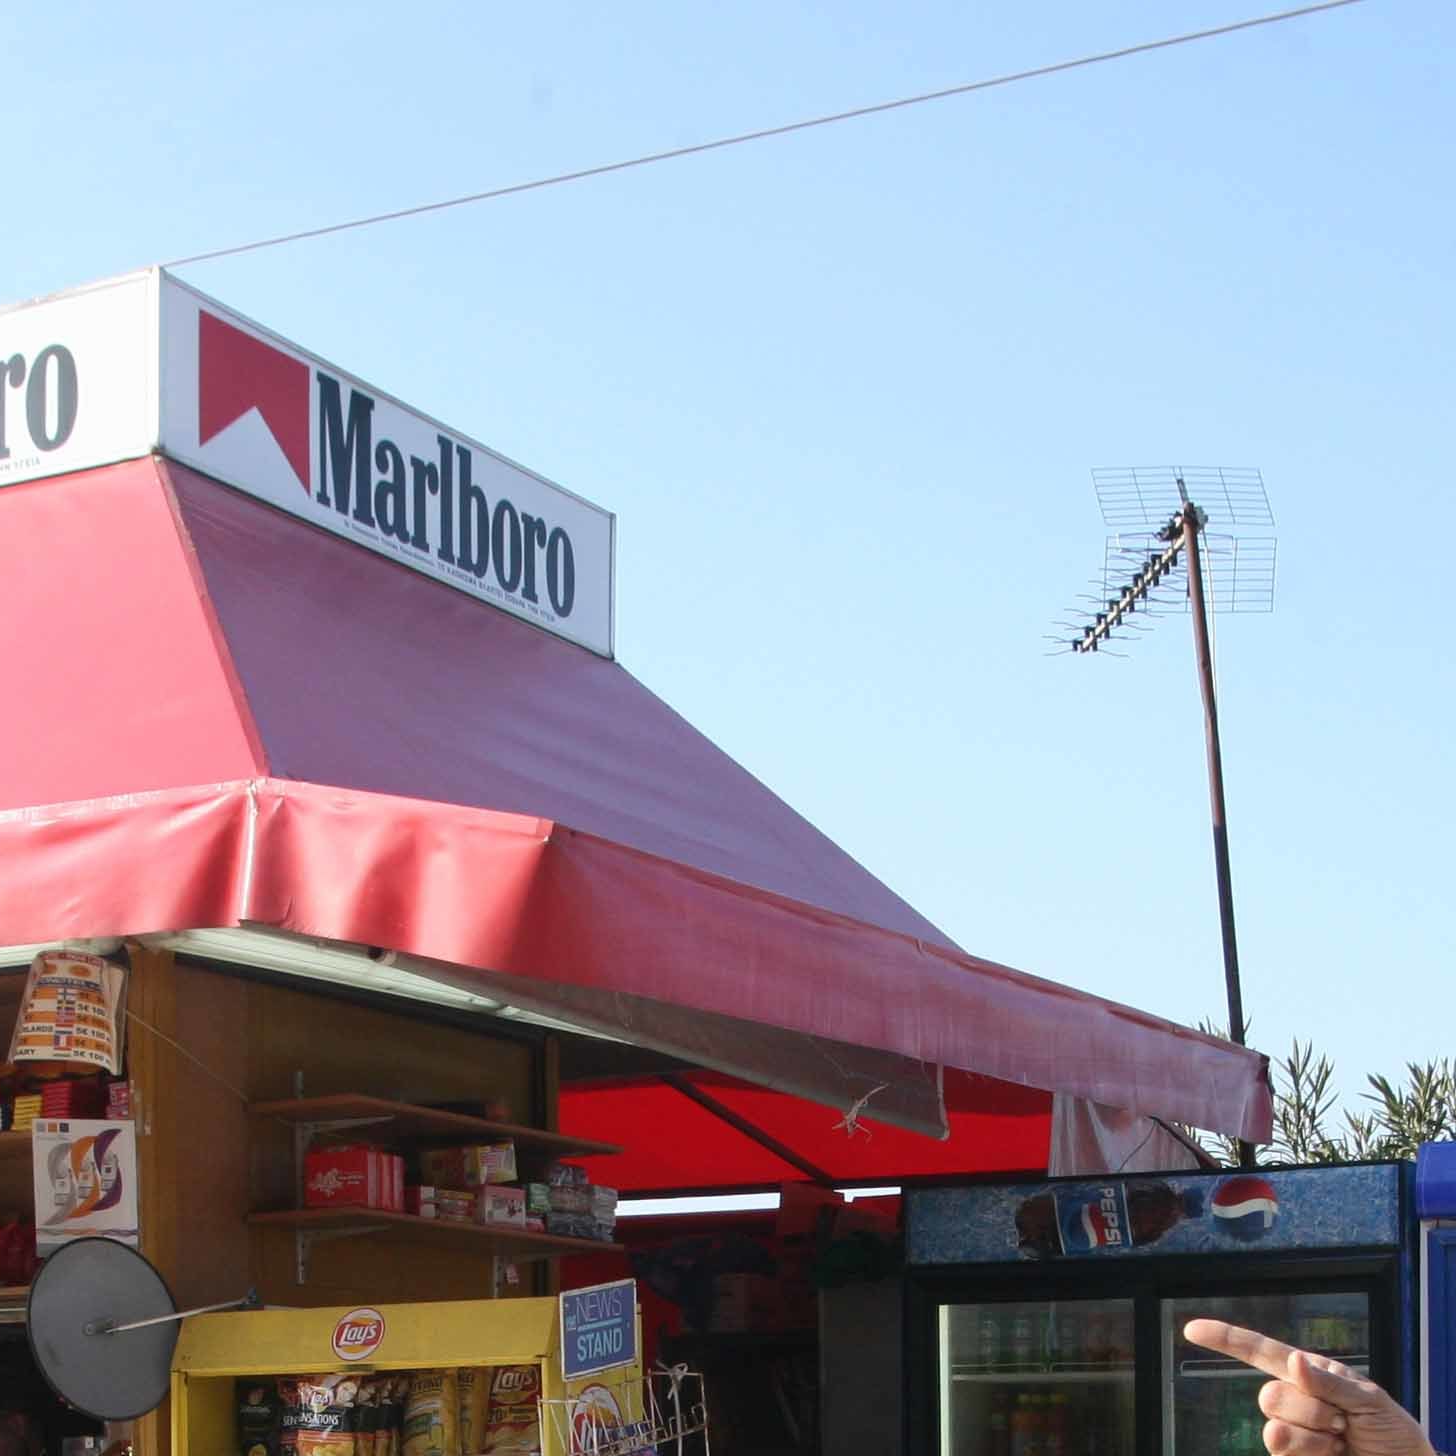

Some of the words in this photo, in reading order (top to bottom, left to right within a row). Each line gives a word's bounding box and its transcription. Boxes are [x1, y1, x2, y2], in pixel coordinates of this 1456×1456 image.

[316, 369, 575, 619] Marlboro
[1098, 1187, 1122, 1245] PEPSI
[575, 1287, 623, 1324] NEWS
[340, 1322, 379, 1346] Lay's
[576, 1327, 623, 1362] STAND
